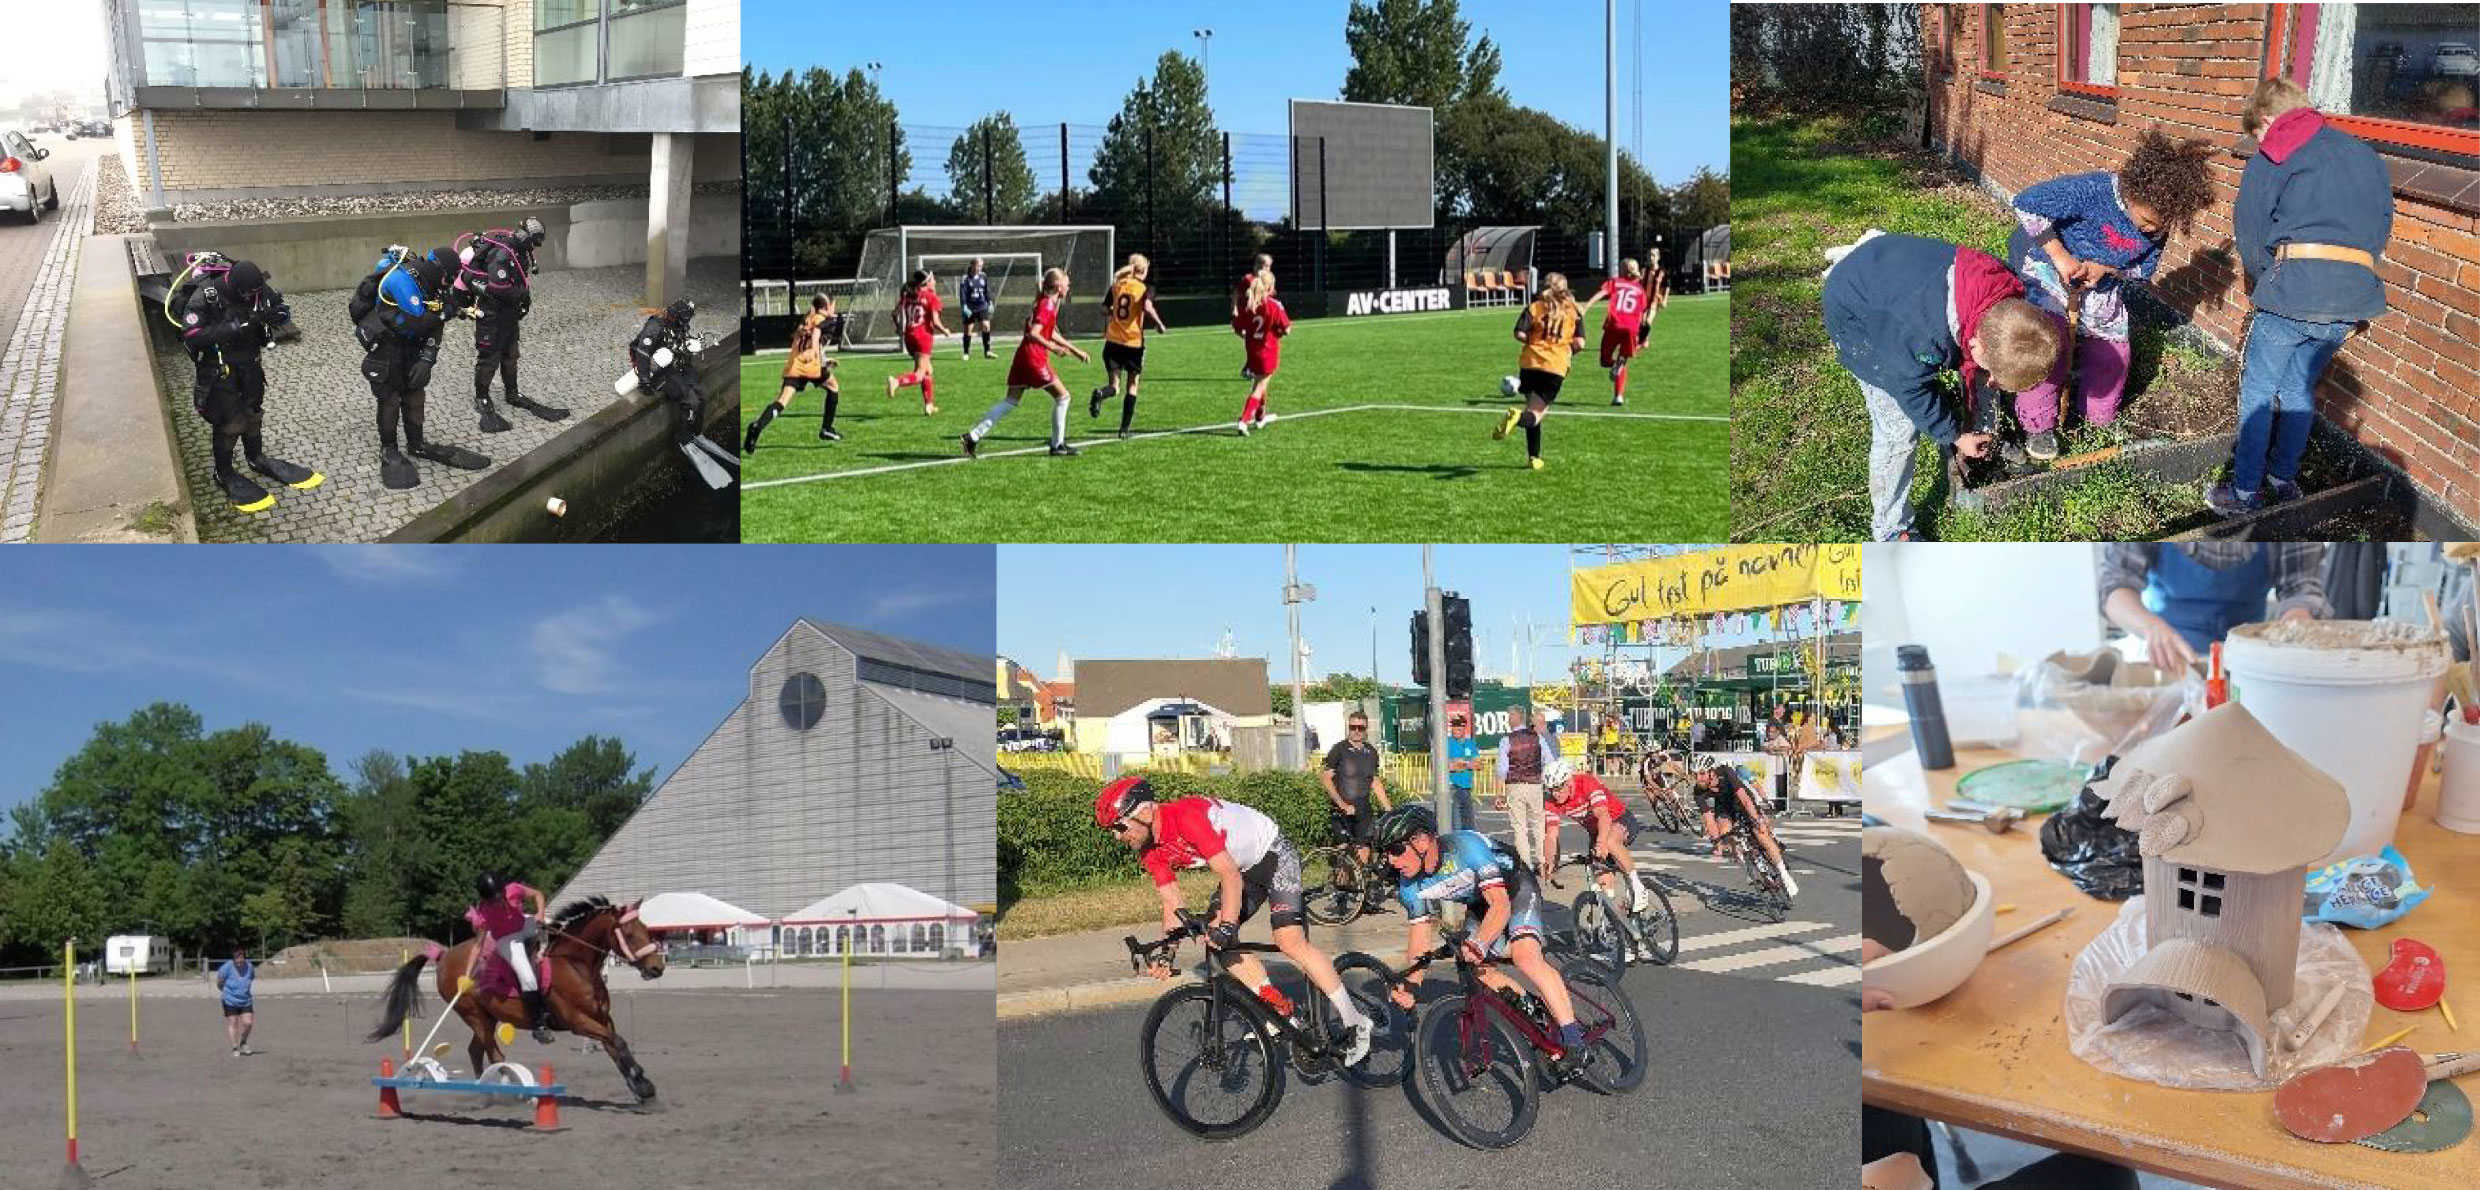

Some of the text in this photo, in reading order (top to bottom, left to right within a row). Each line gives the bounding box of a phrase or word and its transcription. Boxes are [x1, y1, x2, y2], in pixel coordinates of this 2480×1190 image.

[1117, 294, 1131, 320] 8
[1616, 289, 1637, 314] 16
[1253, 315, 1264, 339] 2
[1604, 575, 1648, 616] Gul
[1754, 656, 1791, 672] TUB
